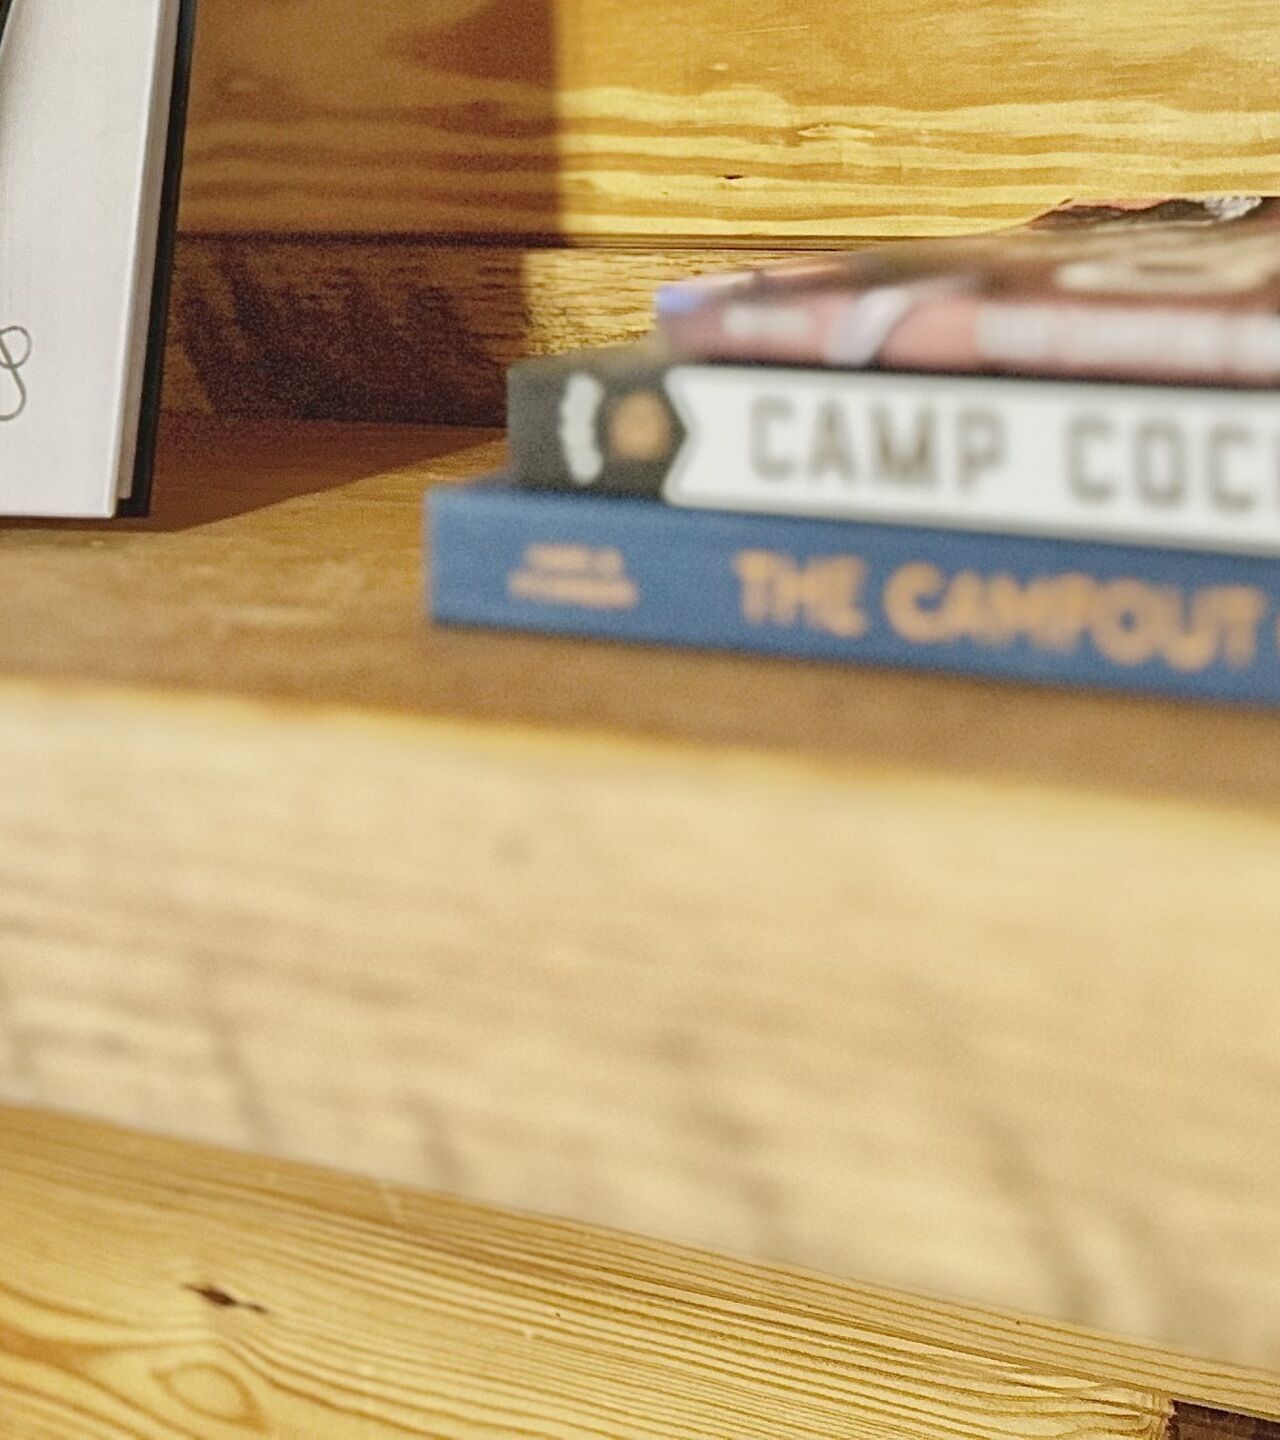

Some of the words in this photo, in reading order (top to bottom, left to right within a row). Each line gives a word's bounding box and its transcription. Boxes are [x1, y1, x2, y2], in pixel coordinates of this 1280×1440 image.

[749, 396, 1009, 490] CAMP
[734, 548, 866, 639] THE
[883, 562, 1268, 672] CAMPOUT
